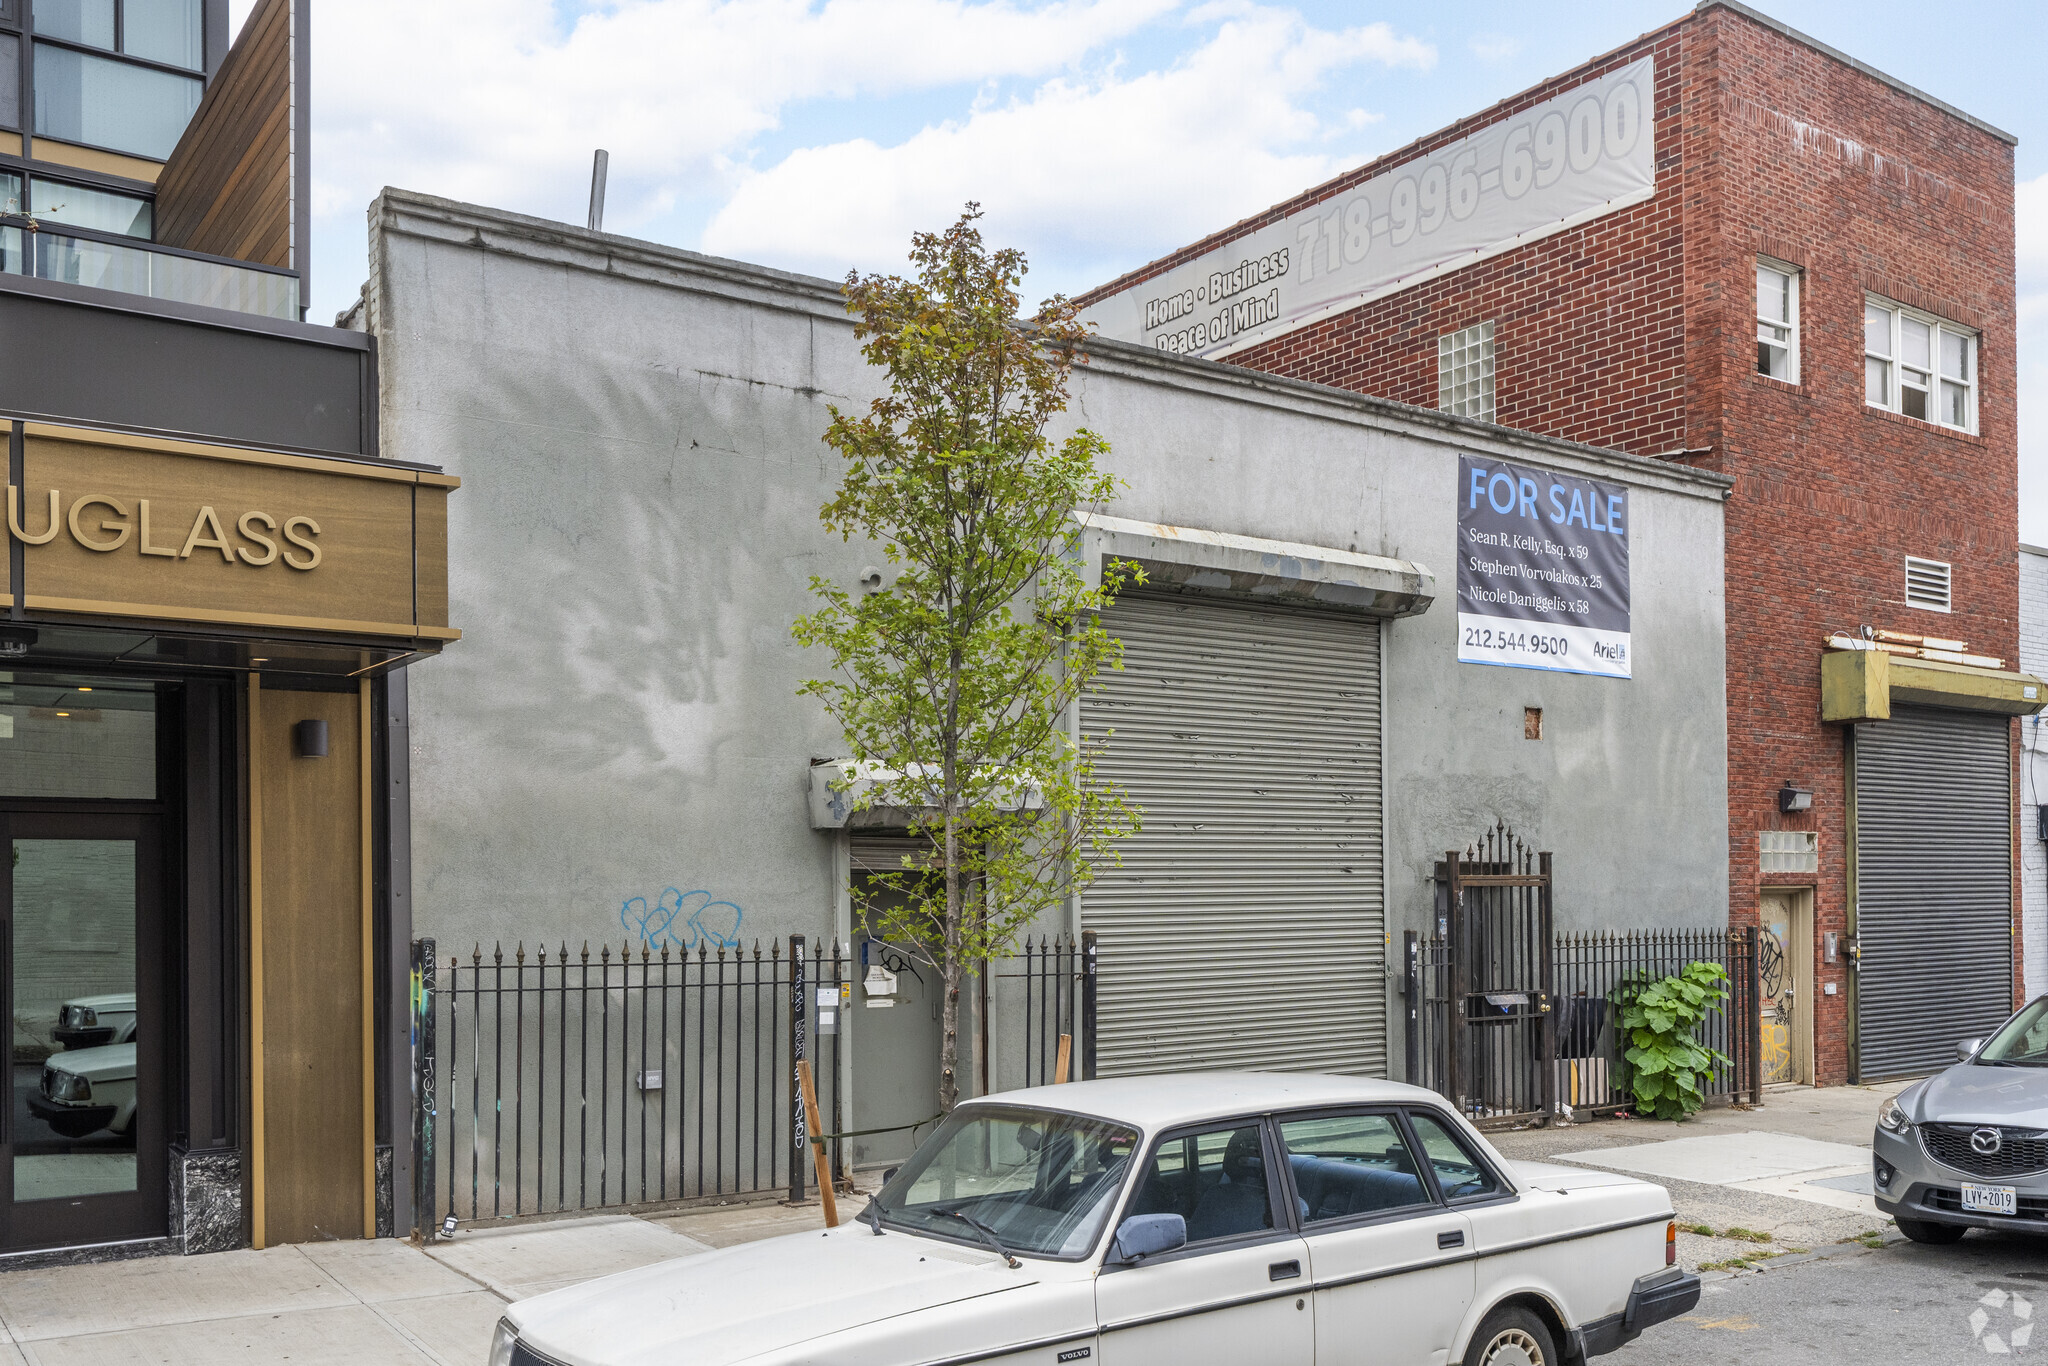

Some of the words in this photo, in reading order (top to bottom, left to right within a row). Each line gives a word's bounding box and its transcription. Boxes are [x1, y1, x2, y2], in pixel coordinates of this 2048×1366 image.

[1297, 79, 1642, 284] 718-996-6900
[1145, 287, 1194, 331] Home
[1208, 247, 1290, 305] Business
[1209, 308, 1229, 343] of
[1231, 287, 1279, 335] Mind
[1469, 467, 1539, 520] FOR
[1548, 483, 1624, 535] SALE
[8, 485, 323, 571] UGLASS
[1469, 527, 1498, 546] Sean
[1500, 532, 1511, 548] R.
[1513, 534, 1543, 556] Kelly,
[1545, 539, 1567, 560] Esq.
[1469, 556, 1518, 577] Stephen
[1519, 563, 1580, 586] Vorvolakos
[1469, 585, 1507, 603] Nicole
[1508, 590, 1567, 613] Daniggelis
[1465, 627, 1568, 657] 212.544.9500
[1593, 641, 1619, 660] Ariel
[1060, 1349, 1089, 1360] VOLVO
